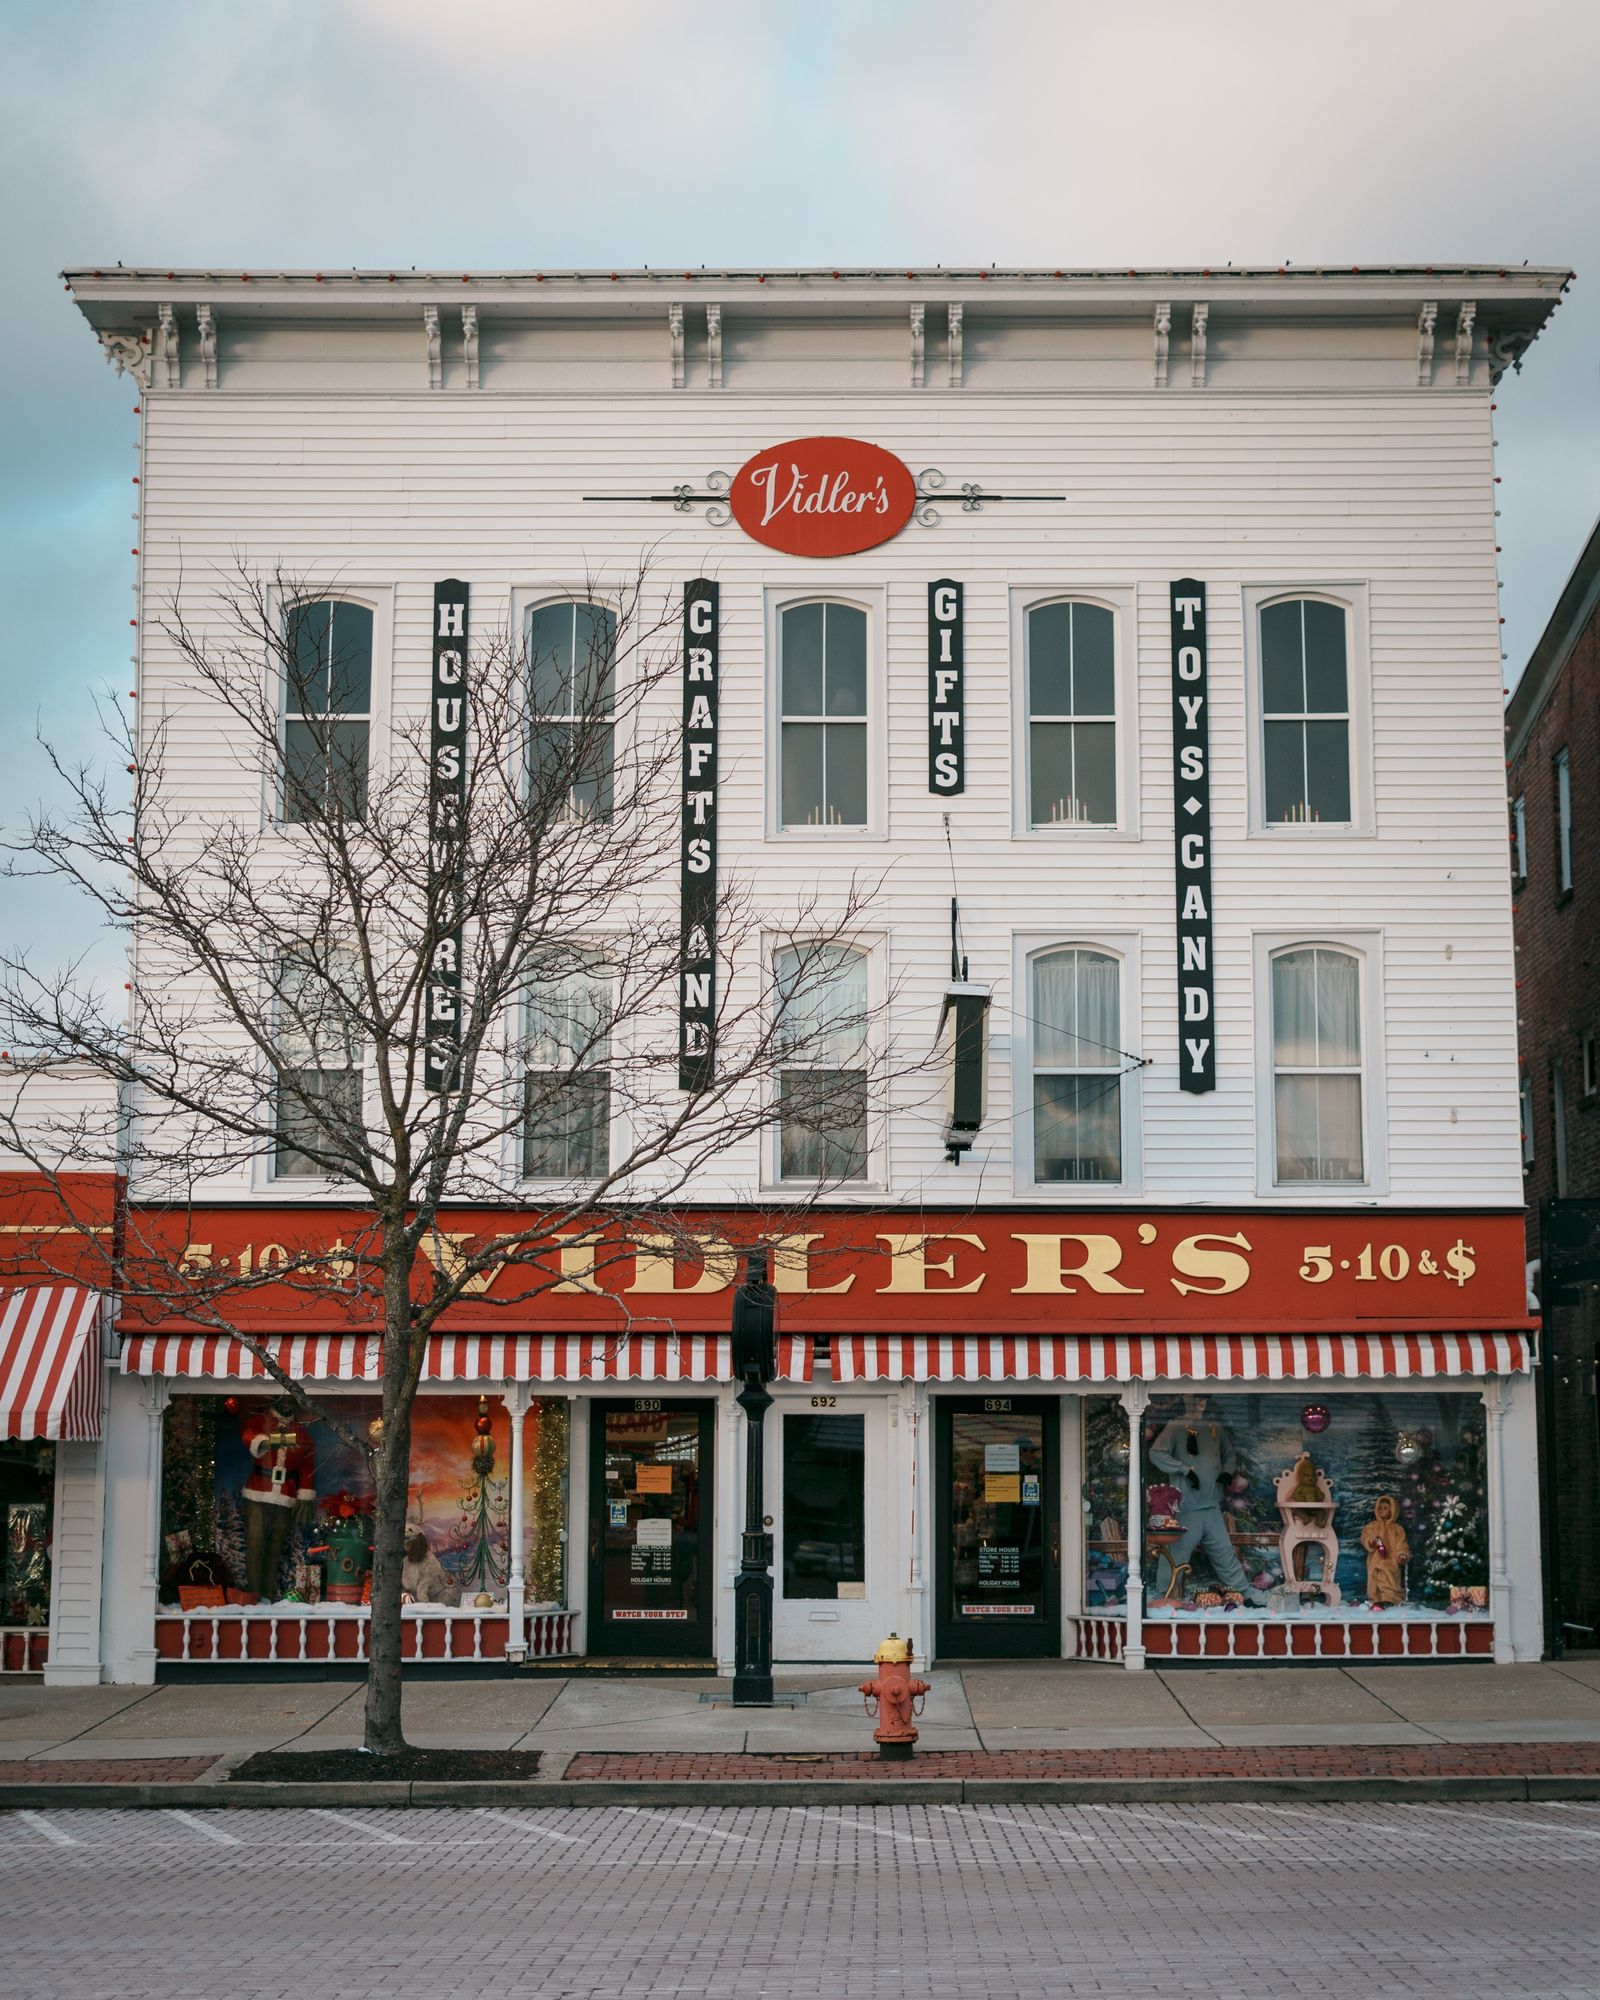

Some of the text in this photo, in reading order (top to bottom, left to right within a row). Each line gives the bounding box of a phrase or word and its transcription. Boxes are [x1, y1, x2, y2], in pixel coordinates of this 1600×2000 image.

[750, 462, 889, 527] Vidler's
[933, 587, 959, 788] GIFTS
[684, 599, 714, 1057] CRAFTS AND
[1175, 597, 1210, 1073] TOYS CANDY
[418, 1222, 1253, 1297] VIDLER'S
[635, 1400, 661, 1411] 690
[811, 1396, 837, 1408] 692
[985, 1400, 1011, 1411] 694
